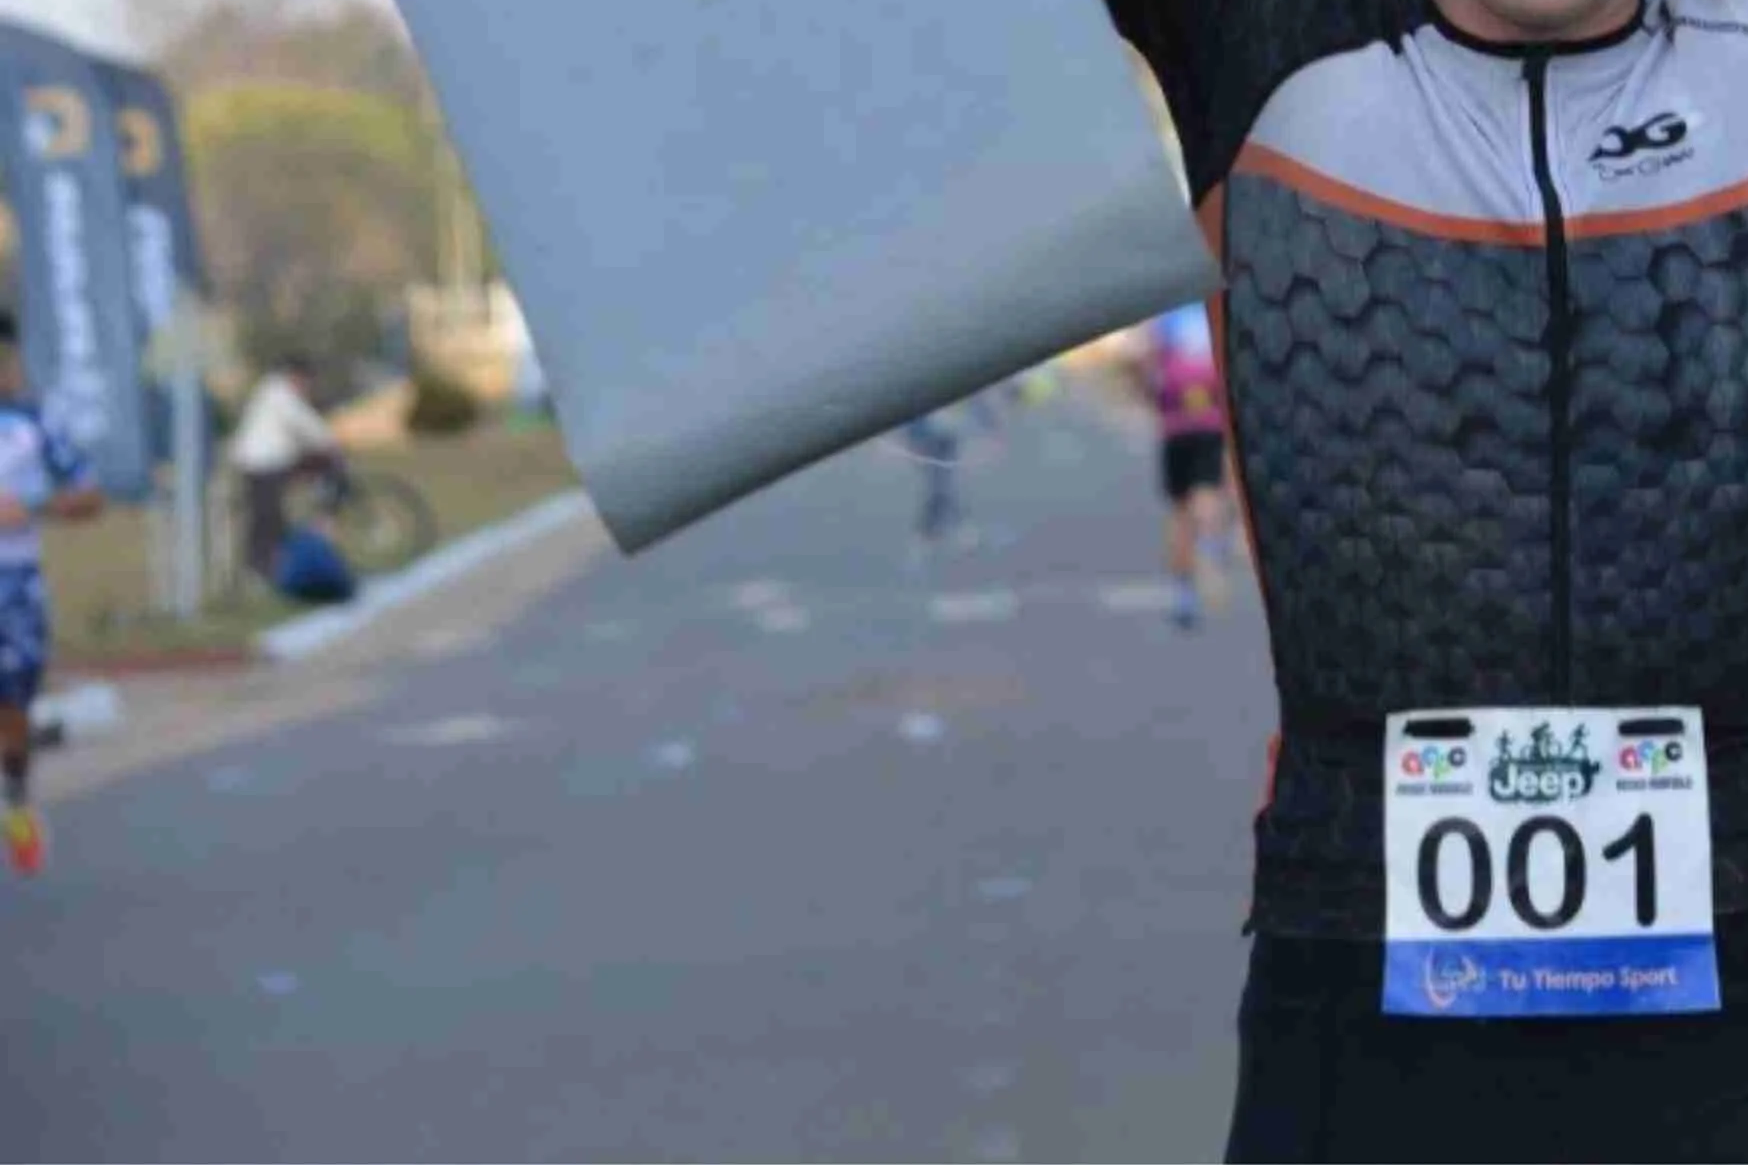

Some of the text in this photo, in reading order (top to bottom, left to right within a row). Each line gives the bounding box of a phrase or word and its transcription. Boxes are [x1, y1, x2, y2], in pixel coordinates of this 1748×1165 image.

[1494, 763, 1585, 803] Jeep
[1417, 812, 1656, 931] 001
[1501, 965, 1678, 995] Tu Tiempo Sport
